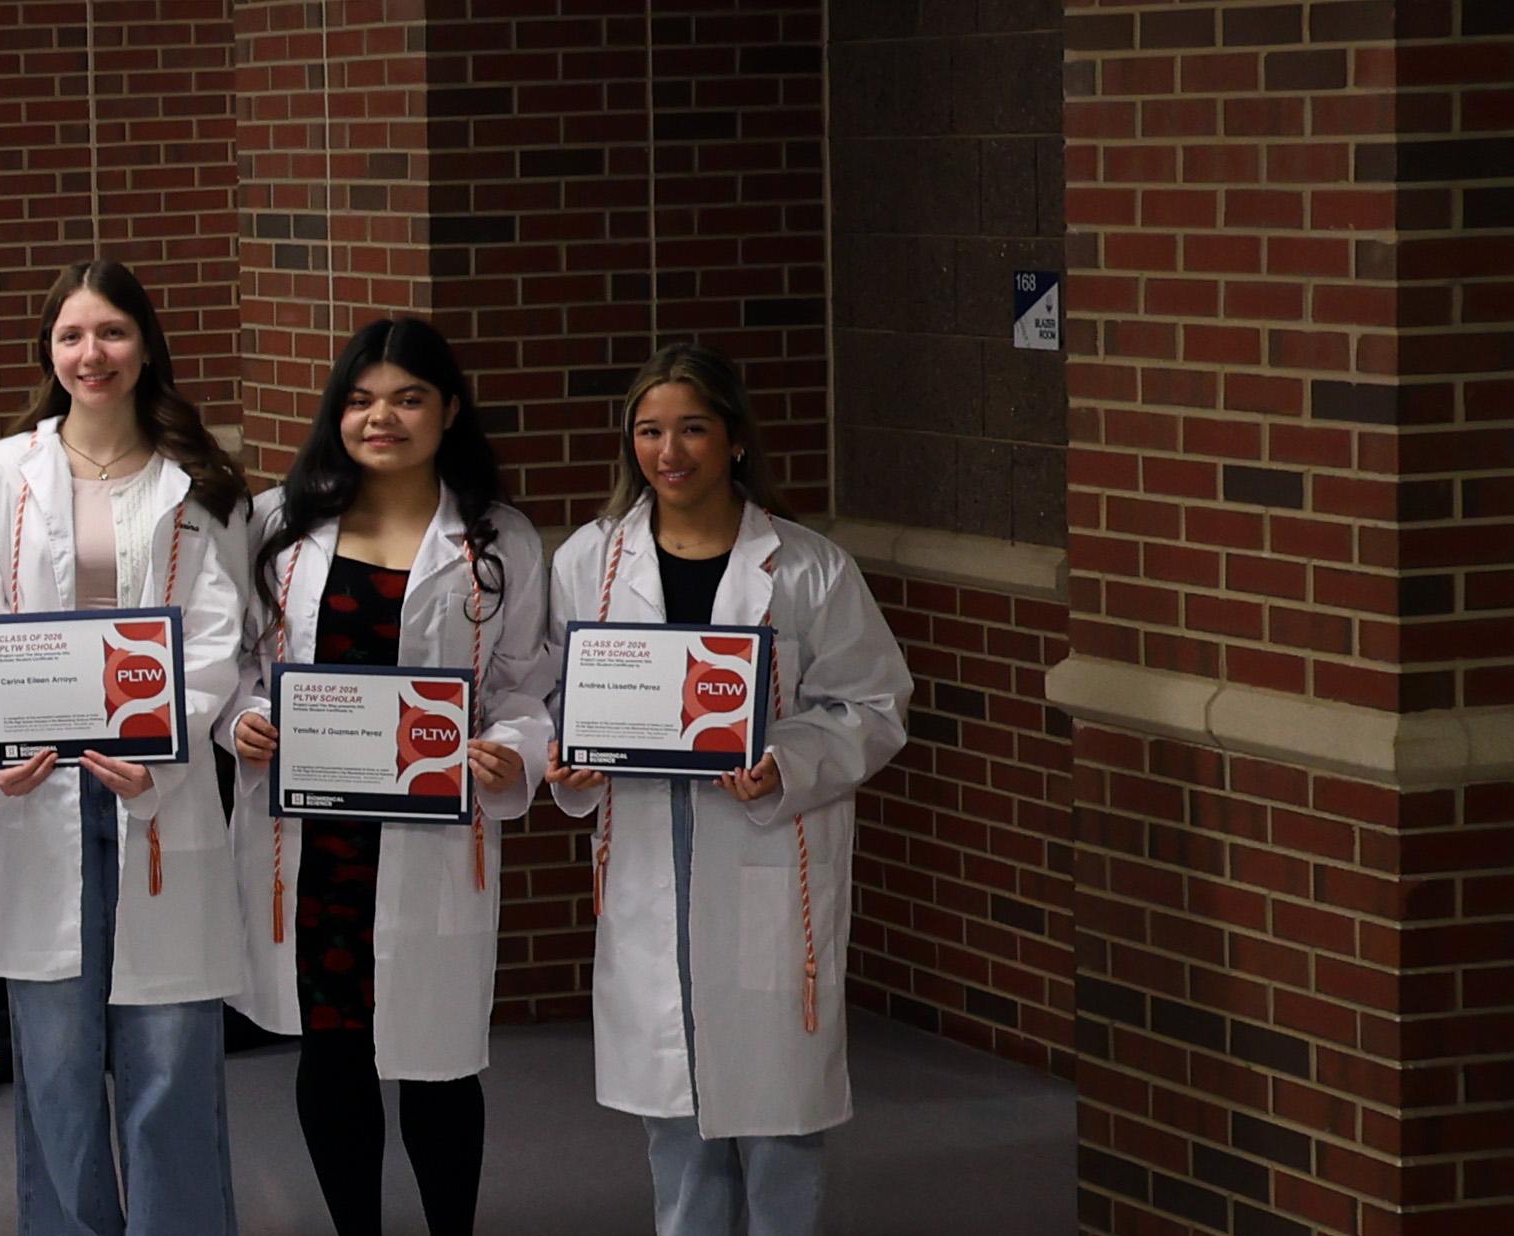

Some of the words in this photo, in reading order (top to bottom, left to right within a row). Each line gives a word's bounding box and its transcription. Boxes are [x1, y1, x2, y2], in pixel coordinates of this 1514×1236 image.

[1016, 273, 1037, 291] 168
[1035, 319, 1056, 328] BLAZER
[1039, 330, 1056, 339] ROOM
[0, 635, 27, 643] CLASS
[26, 643, 67, 651] SCHOLAR
[608, 650, 650, 658] SCHOLAR
[118, 668, 163, 682] PLTW
[697, 682, 744, 695] PLTW
[320, 695, 363, 703] SCHOLAR
[412, 728, 457, 740] PLTW
